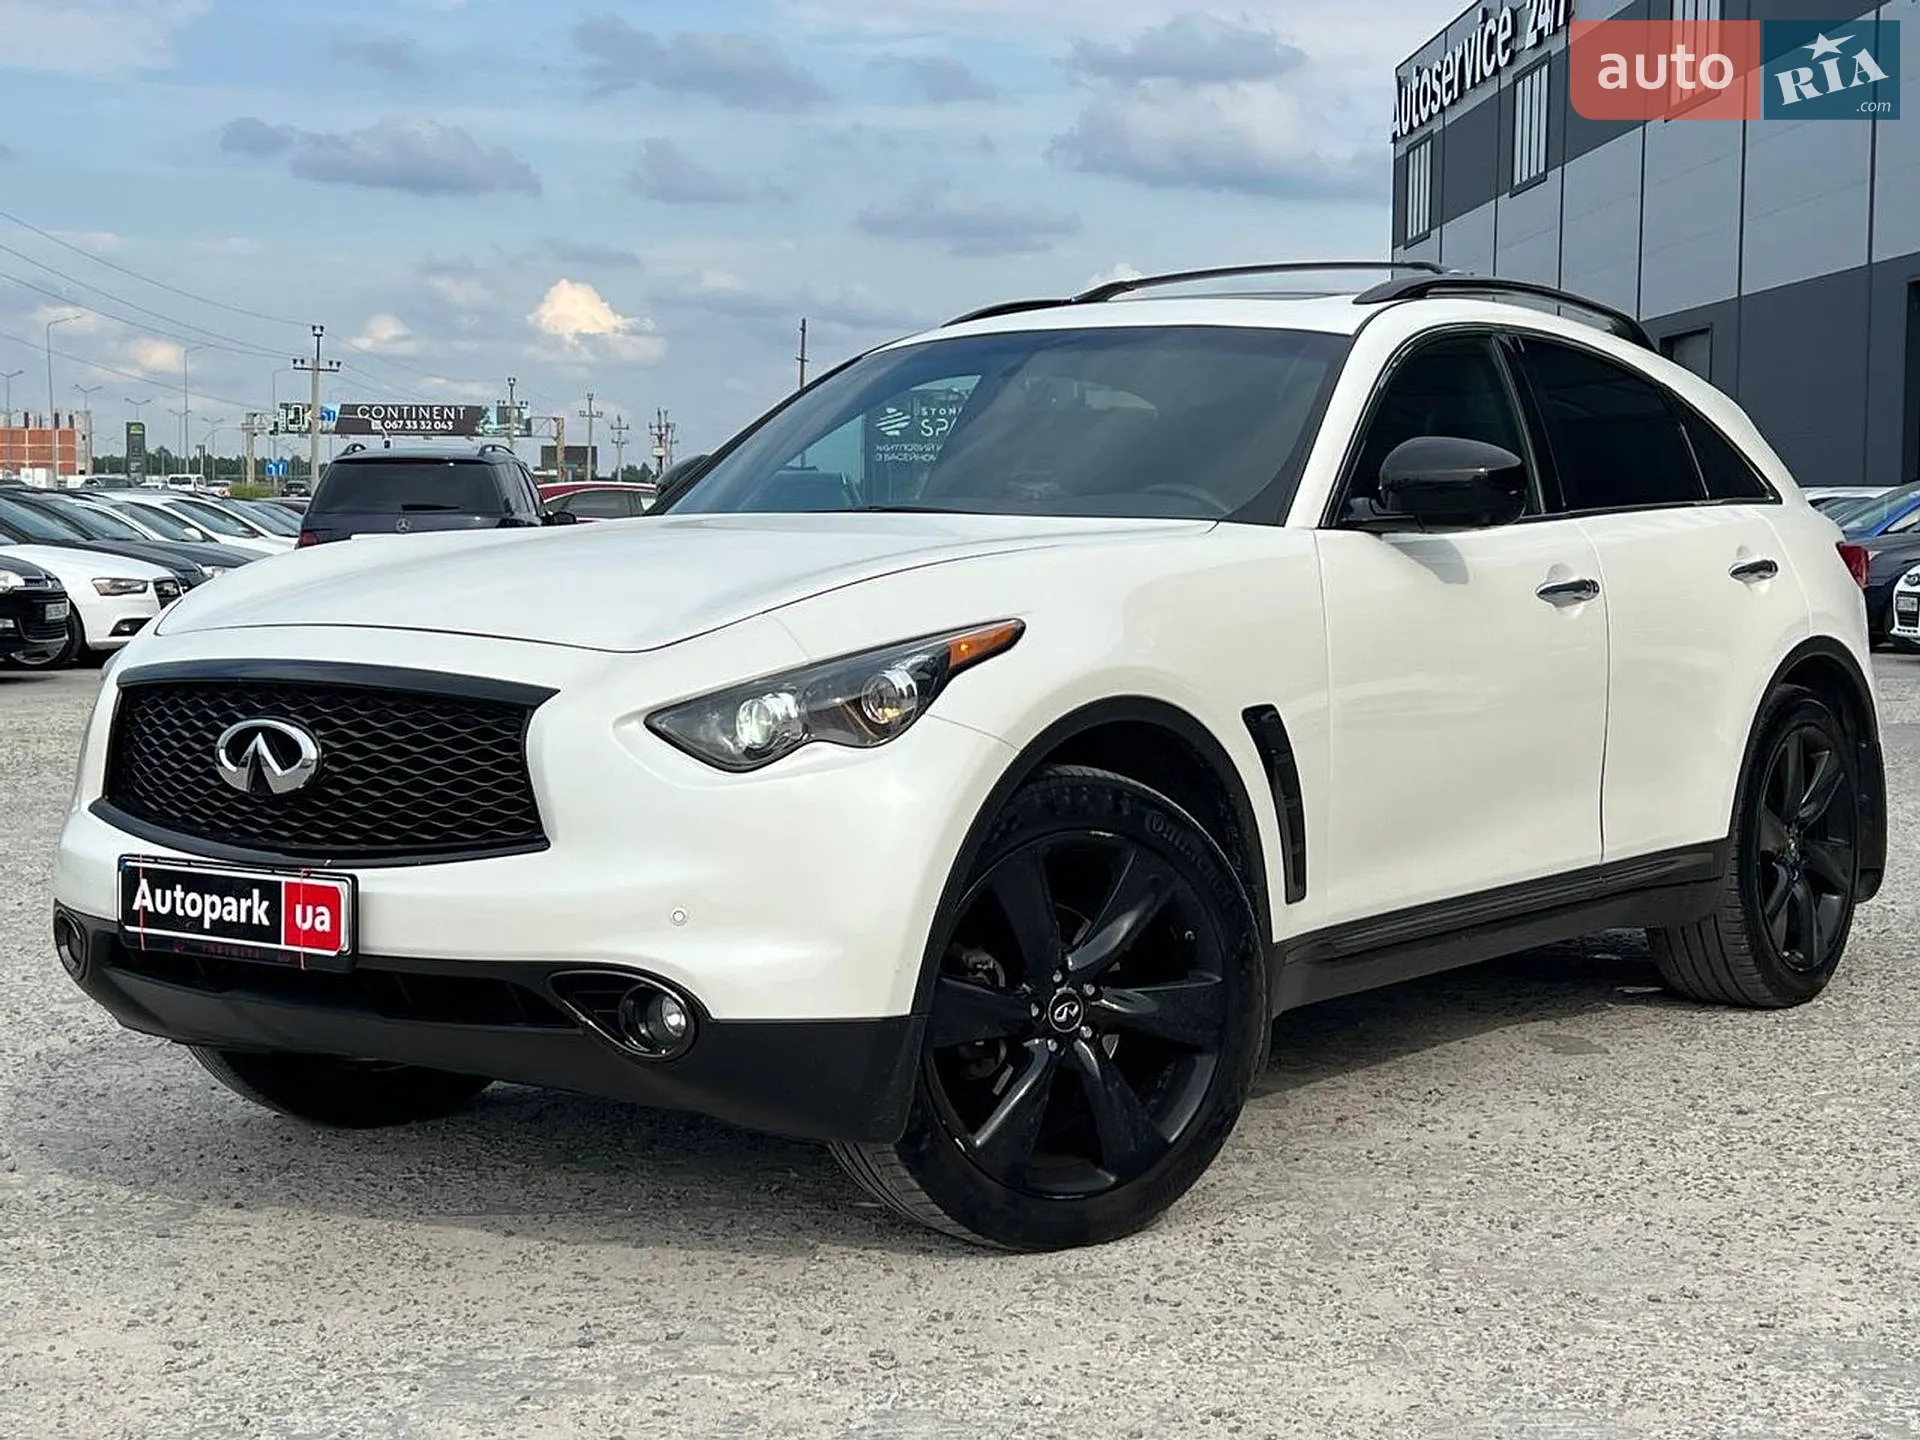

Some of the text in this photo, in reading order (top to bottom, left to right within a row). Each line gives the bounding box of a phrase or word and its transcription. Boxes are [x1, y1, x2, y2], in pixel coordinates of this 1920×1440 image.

[1392, 6, 1512, 138] Autoservice
[356, 405, 466, 420] CONTINENT
[920, 405, 962, 416] STON
[384, 420, 403, 430] 067
[132, 878, 331, 932] Autopark ua
